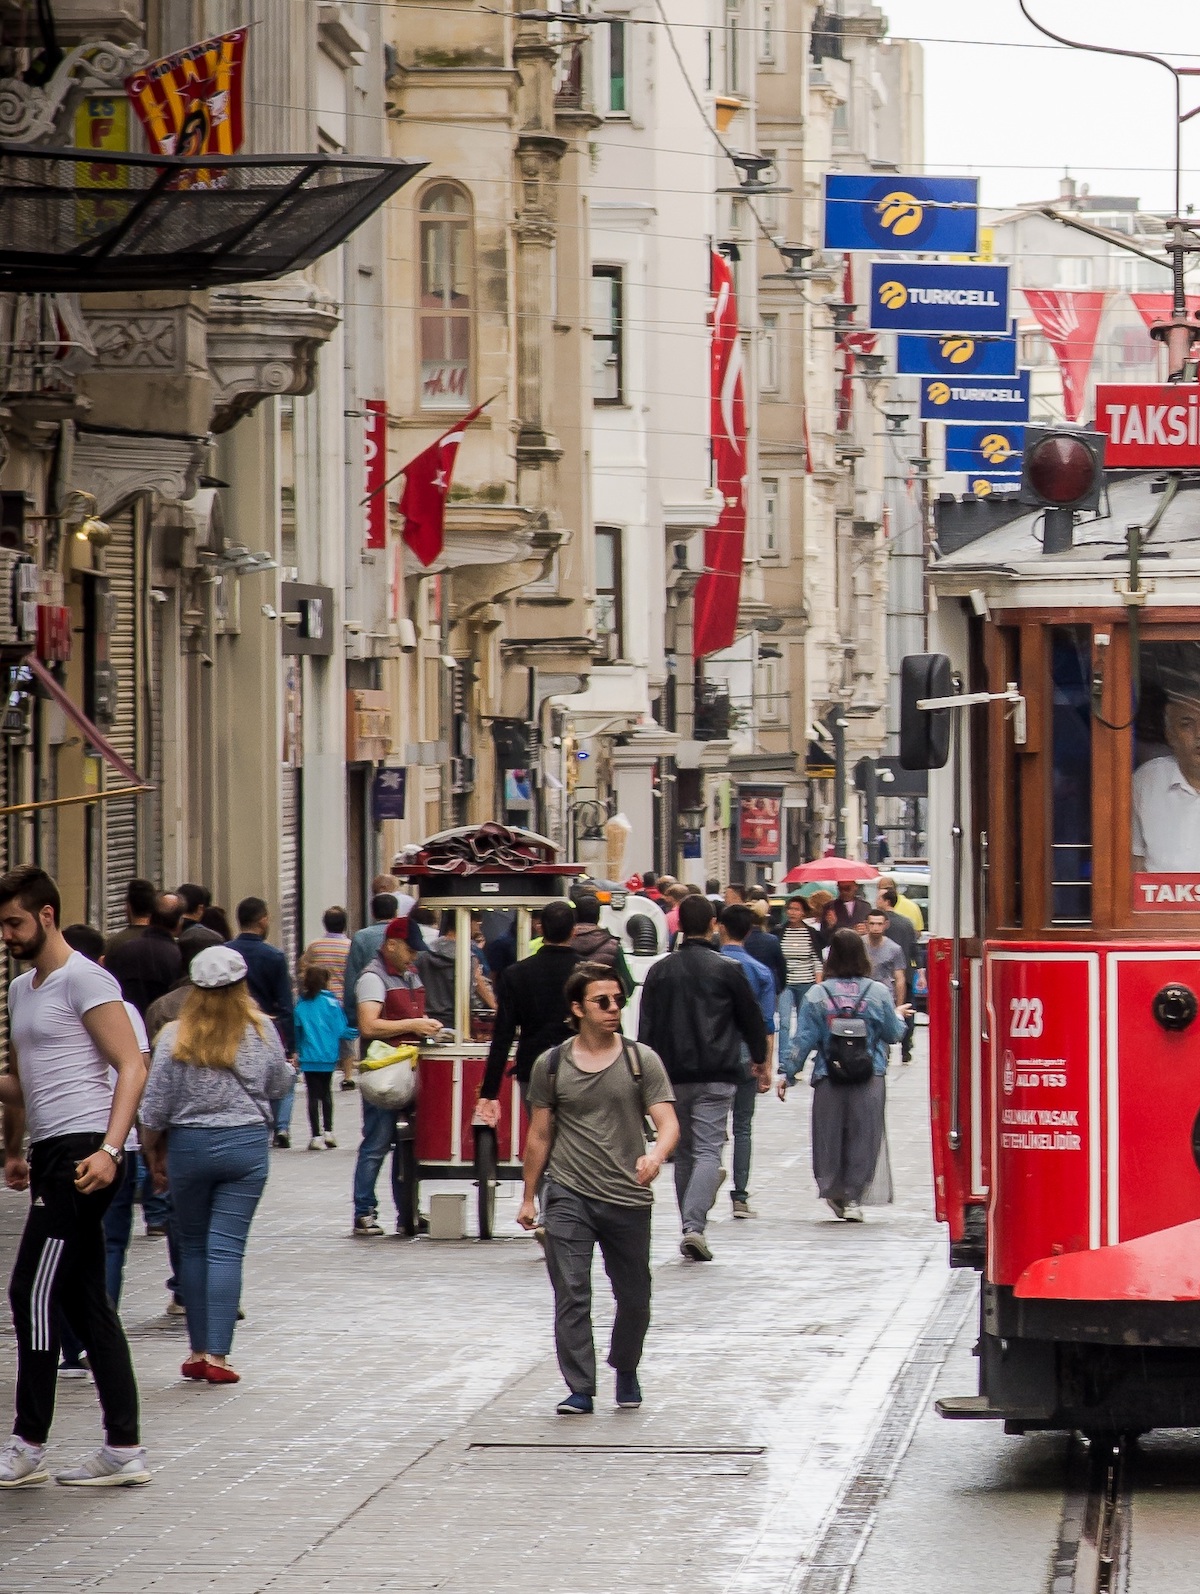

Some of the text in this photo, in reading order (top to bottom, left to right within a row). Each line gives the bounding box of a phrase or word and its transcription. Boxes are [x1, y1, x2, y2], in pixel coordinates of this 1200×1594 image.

[908, 288, 1000, 307] TURKCELL
[950, 387, 1025, 402] TURKCELL
[1009, 998, 1043, 1038] 223
[1041, 1074, 1067, 1087] 153
